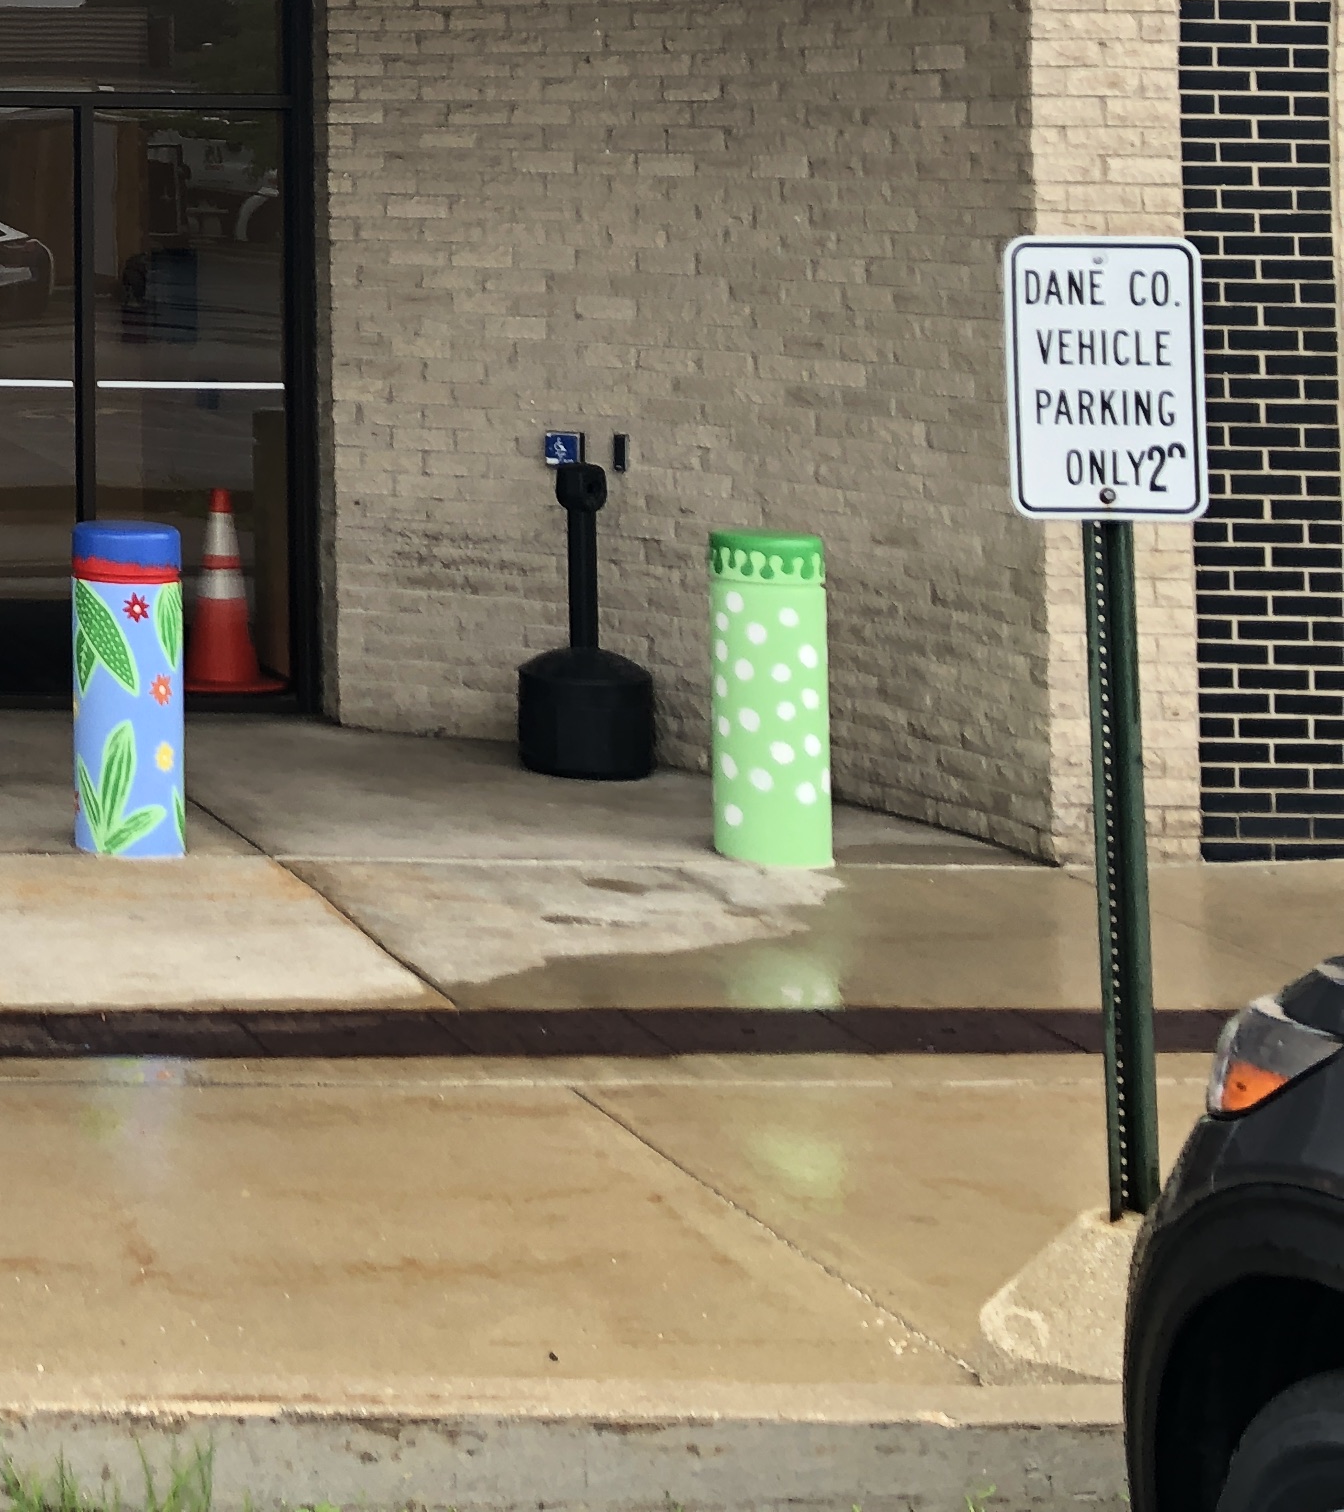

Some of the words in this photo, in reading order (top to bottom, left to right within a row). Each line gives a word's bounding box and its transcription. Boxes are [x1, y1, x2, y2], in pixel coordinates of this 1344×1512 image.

[1024, 269, 1105, 306] DANE
[1129, 270, 1181, 307] CO.
[1036, 328, 1172, 367] VEHICLE
[1035, 389, 1176, 427] PARKING
[1066, 449, 1145, 487] ONLY
